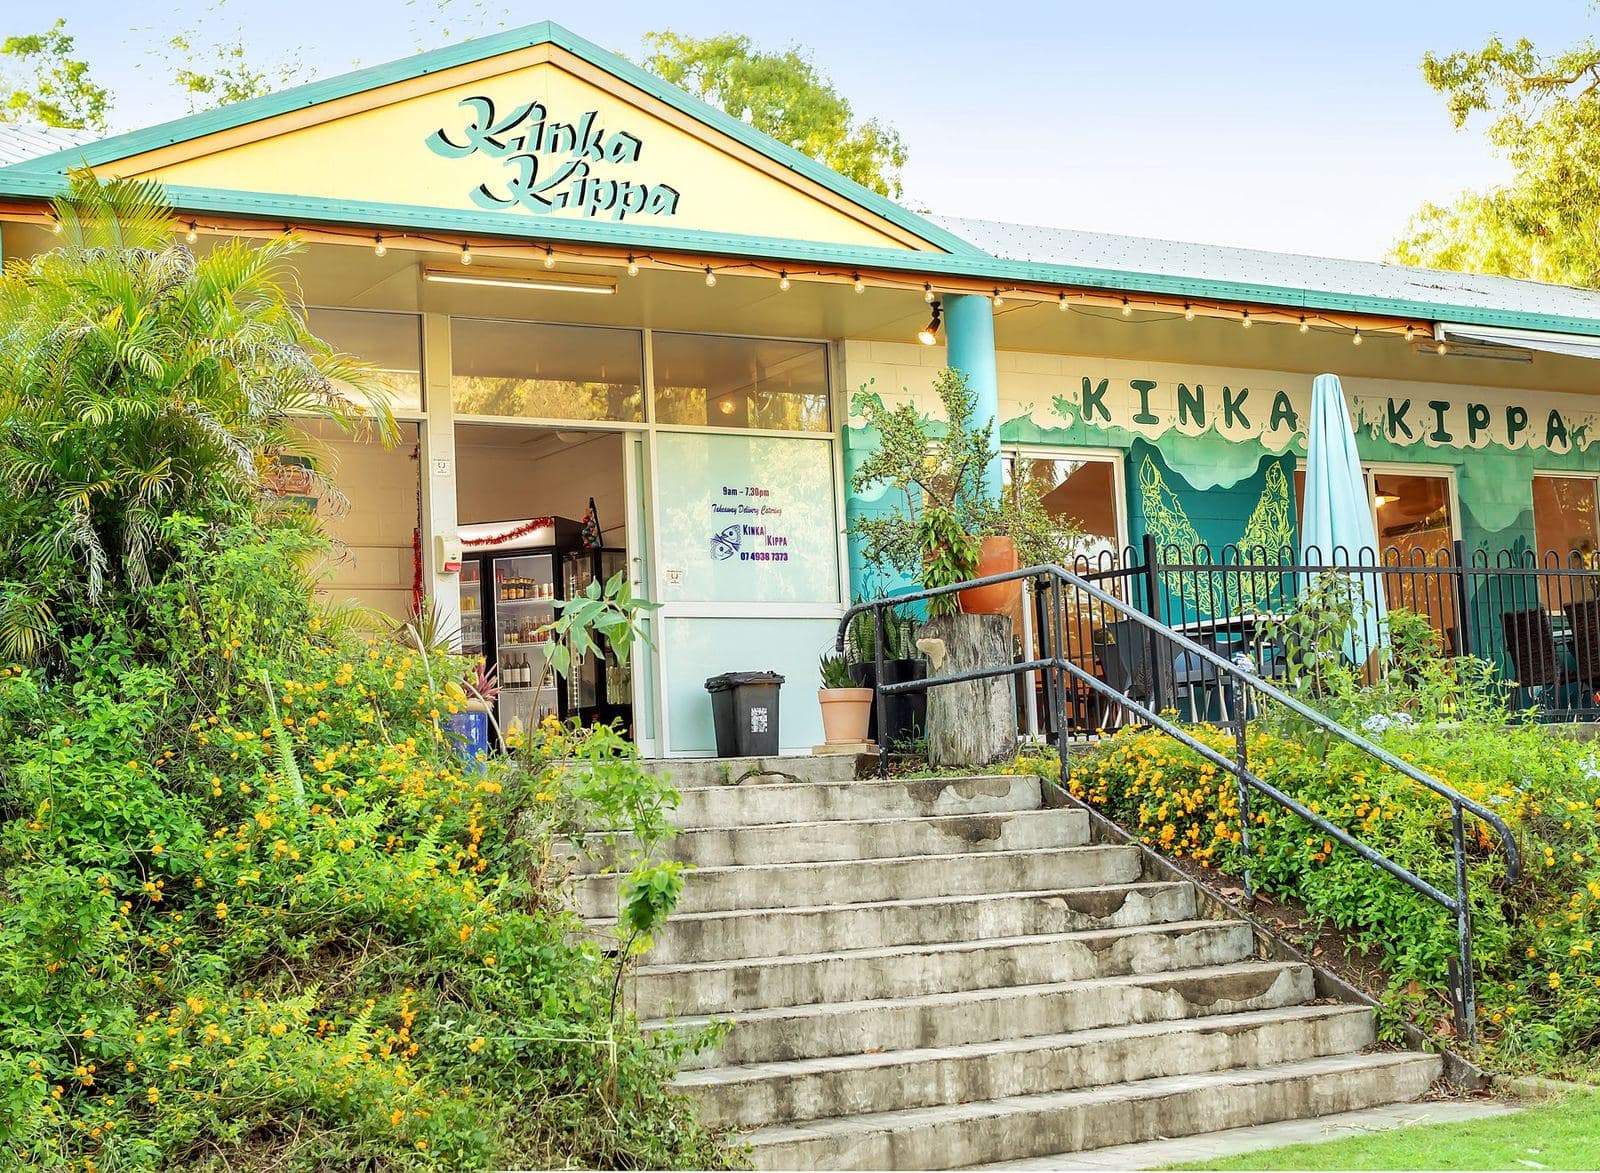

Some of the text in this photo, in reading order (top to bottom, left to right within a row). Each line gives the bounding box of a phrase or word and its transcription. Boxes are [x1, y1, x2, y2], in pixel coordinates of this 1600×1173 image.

[425, 96, 642, 163] Kinka
[468, 153, 680, 220] Kippa
[1082, 376, 1567, 448] KINKA KIPPA
[722, 486, 738, 496] 9am
[745, 486, 770, 498] 7.30pm
[740, 552, 750, 561] 07
